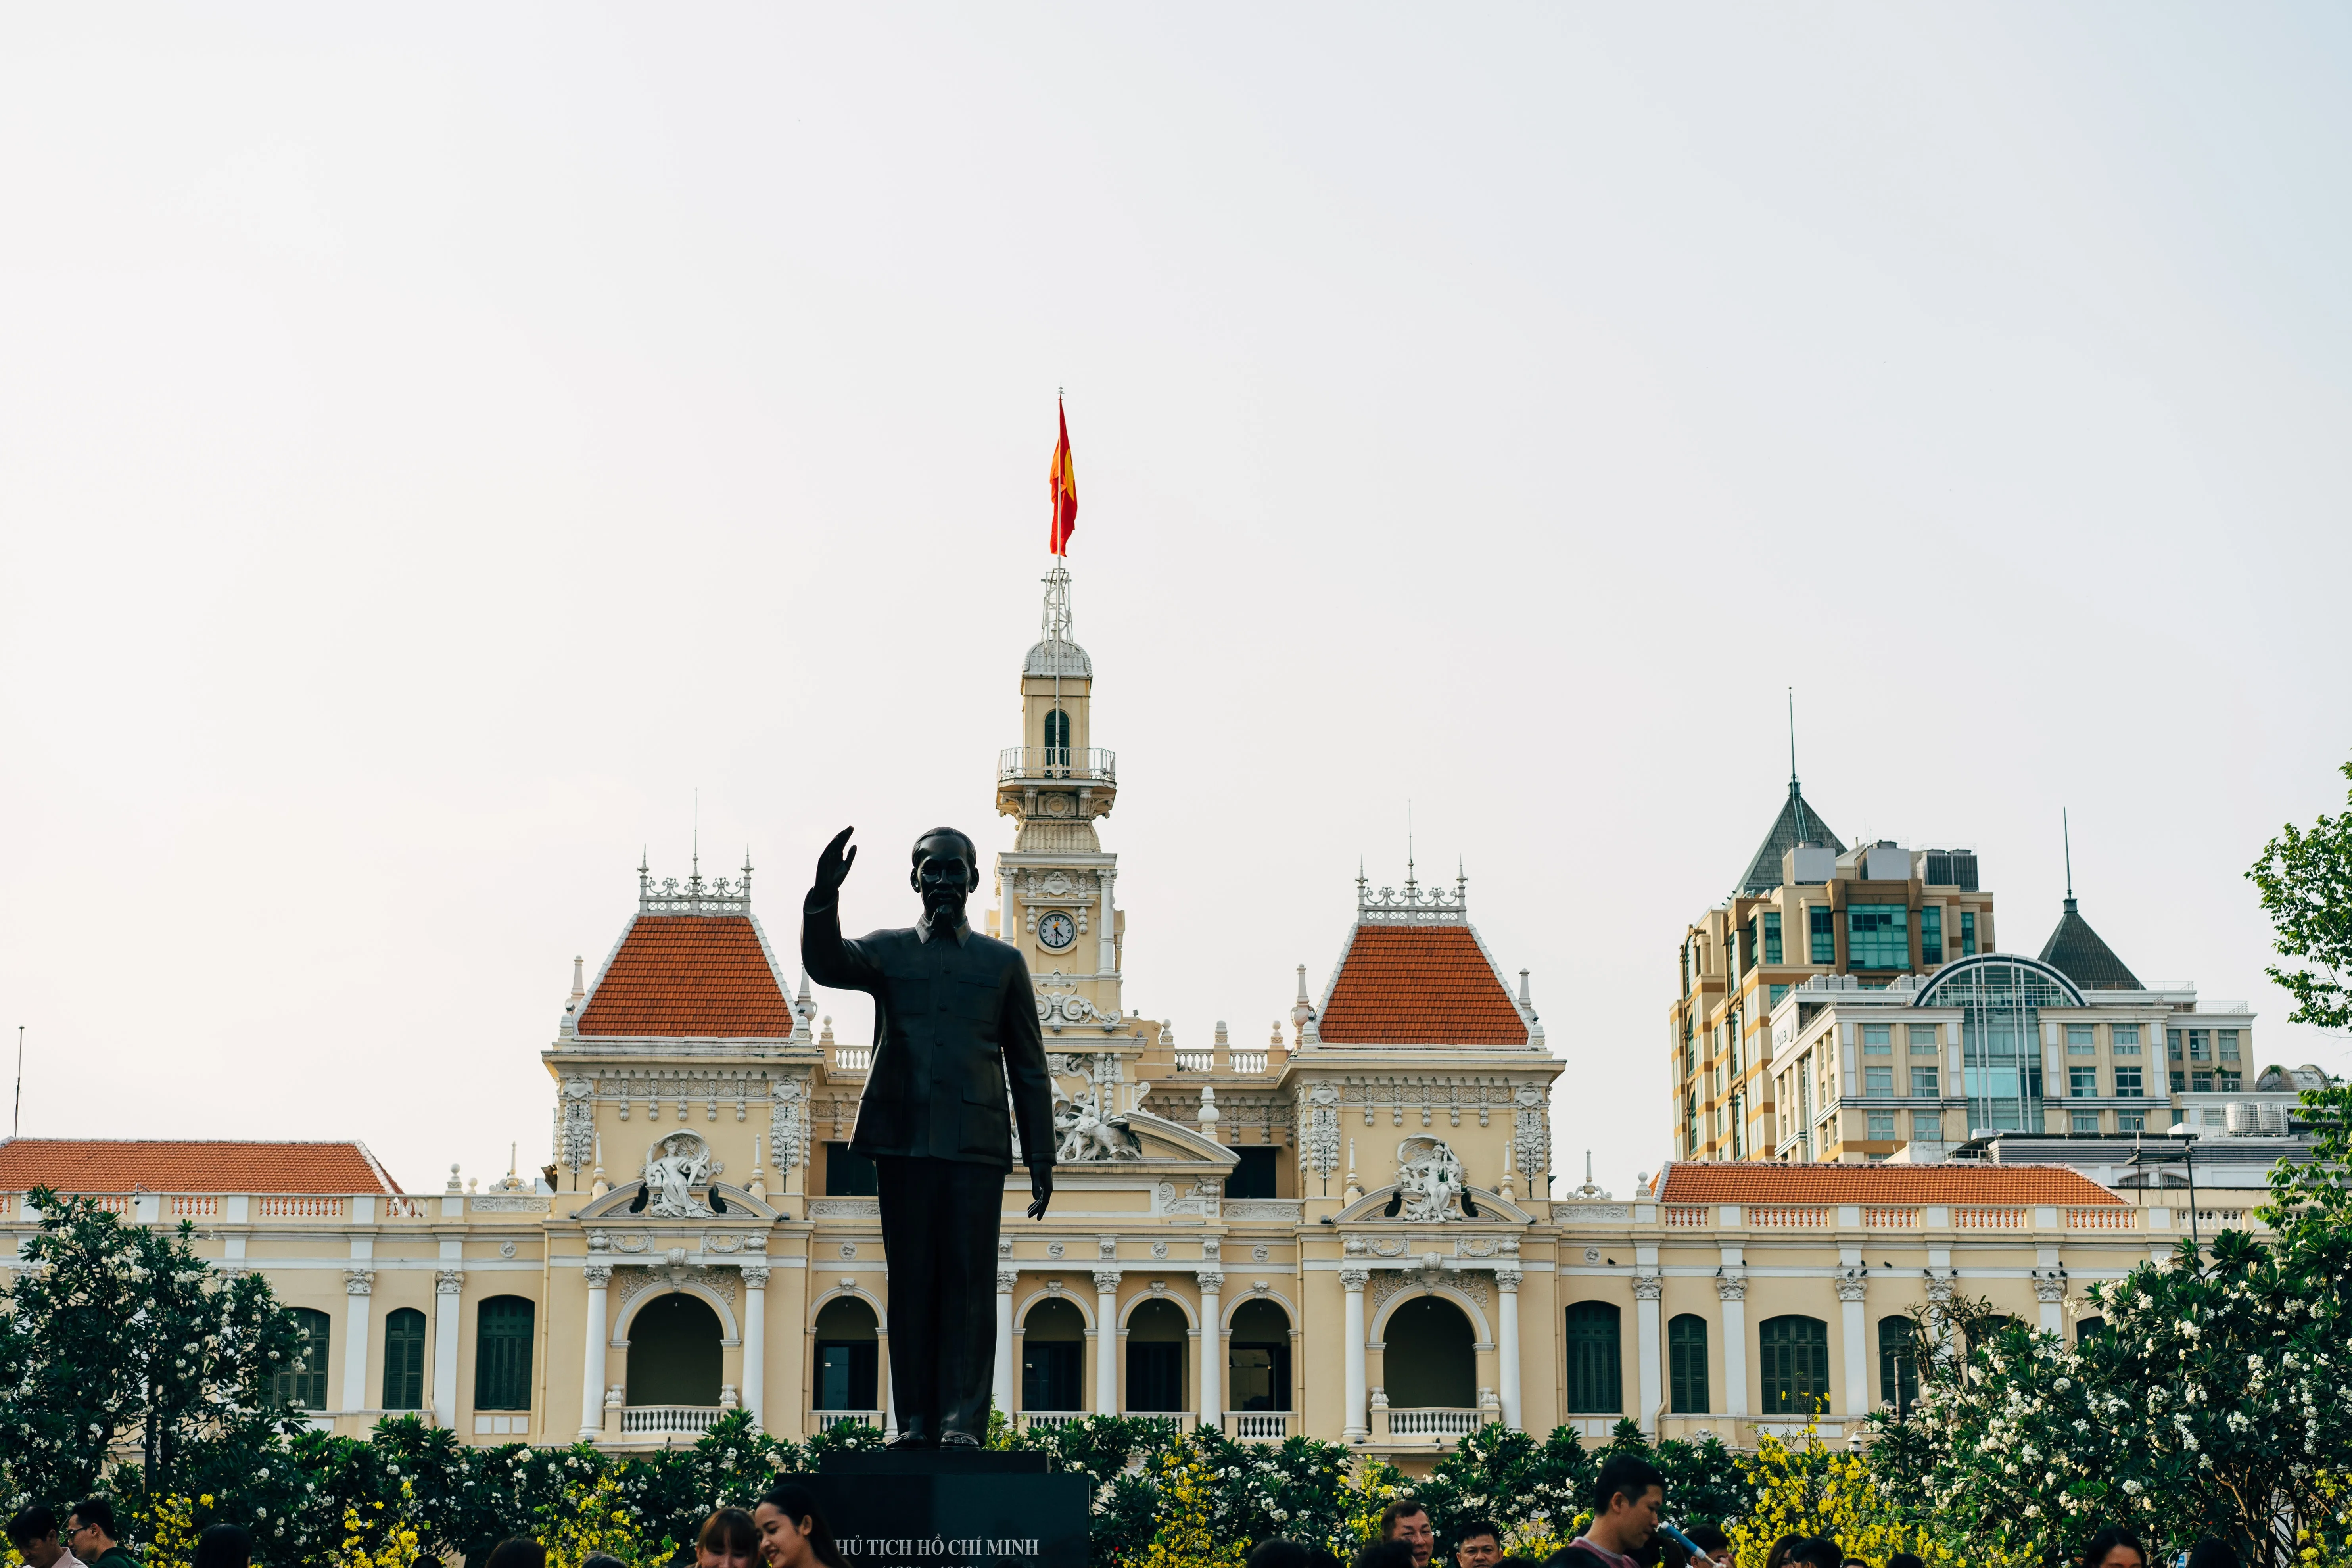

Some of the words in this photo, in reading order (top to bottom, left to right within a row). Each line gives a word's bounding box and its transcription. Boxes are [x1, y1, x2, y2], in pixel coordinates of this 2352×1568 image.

[833, 1535, 863, 1555] HỦ
[867, 1539, 913, 1558] TỊCH
[917, 1533, 944, 1555] HỒ
[948, 1535, 982, 1555] CHÍ
[986, 1539, 1039, 1555] MINH
